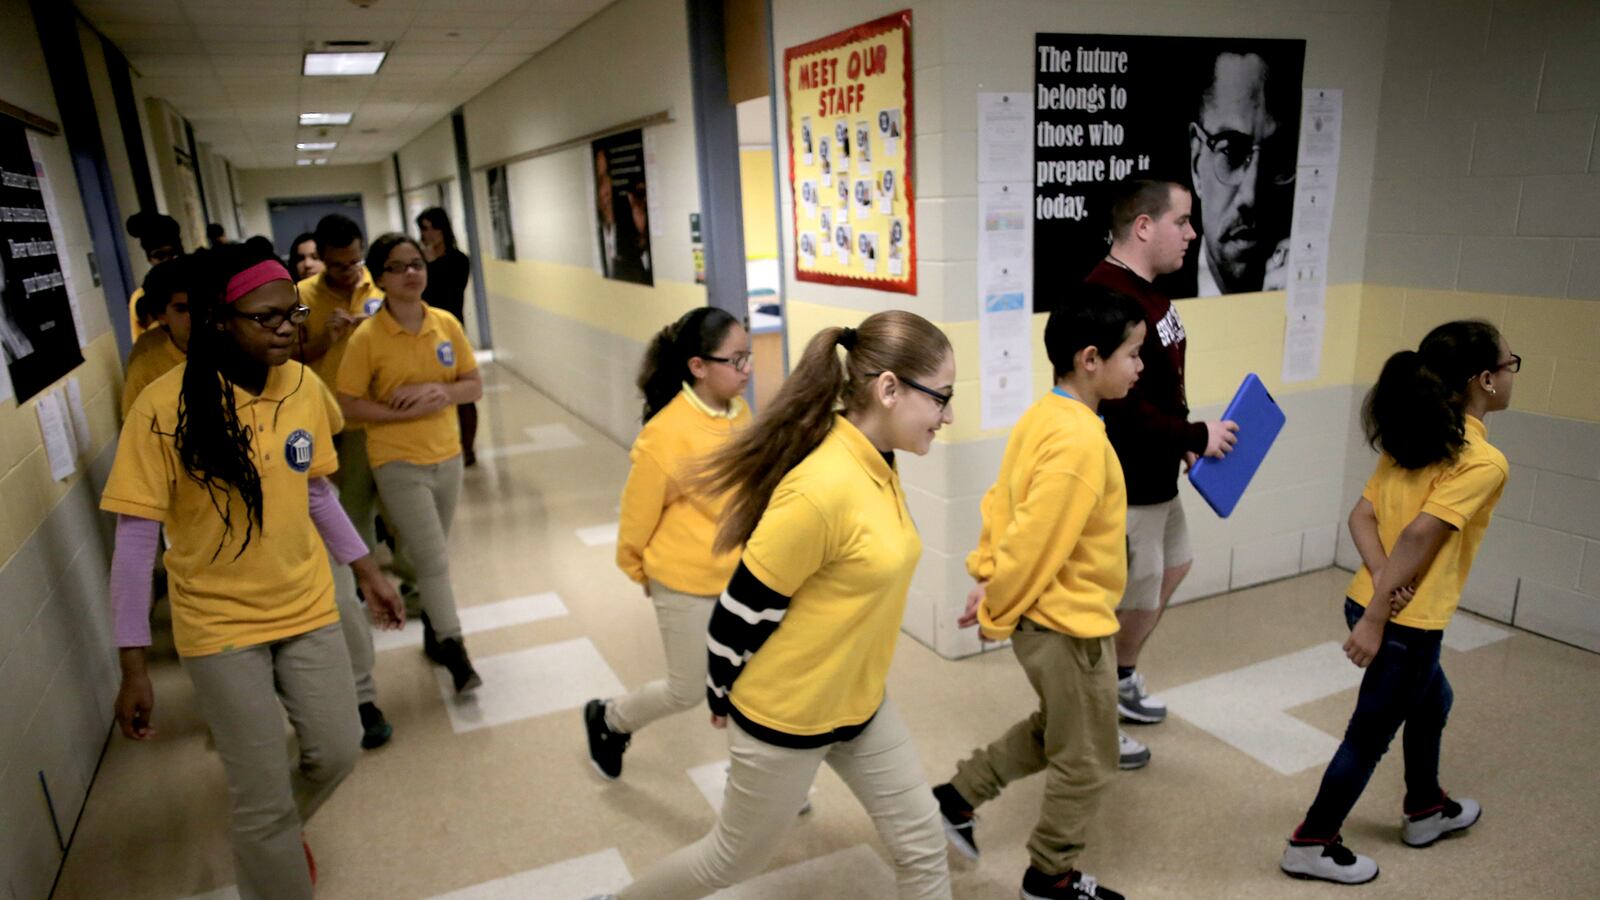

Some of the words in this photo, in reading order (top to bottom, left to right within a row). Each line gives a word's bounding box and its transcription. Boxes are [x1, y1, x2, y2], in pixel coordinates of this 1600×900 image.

[798, 57, 838, 91] MEET
[847, 44, 888, 80] OUR
[1038, 46, 1072, 73] The
[1076, 46, 1128, 73] future
[818, 83, 865, 118] STAFF
[1037, 83, 1106, 113] belongs
[1110, 84, 1128, 110] to
[1037, 121, 1084, 147] those
[1088, 120, 1125, 146] who
[1036, 159, 1105, 187] prepare
[1109, 155, 1134, 181] for
[1138, 154, 1150, 171] it
[1036, 193, 1089, 221] today.
